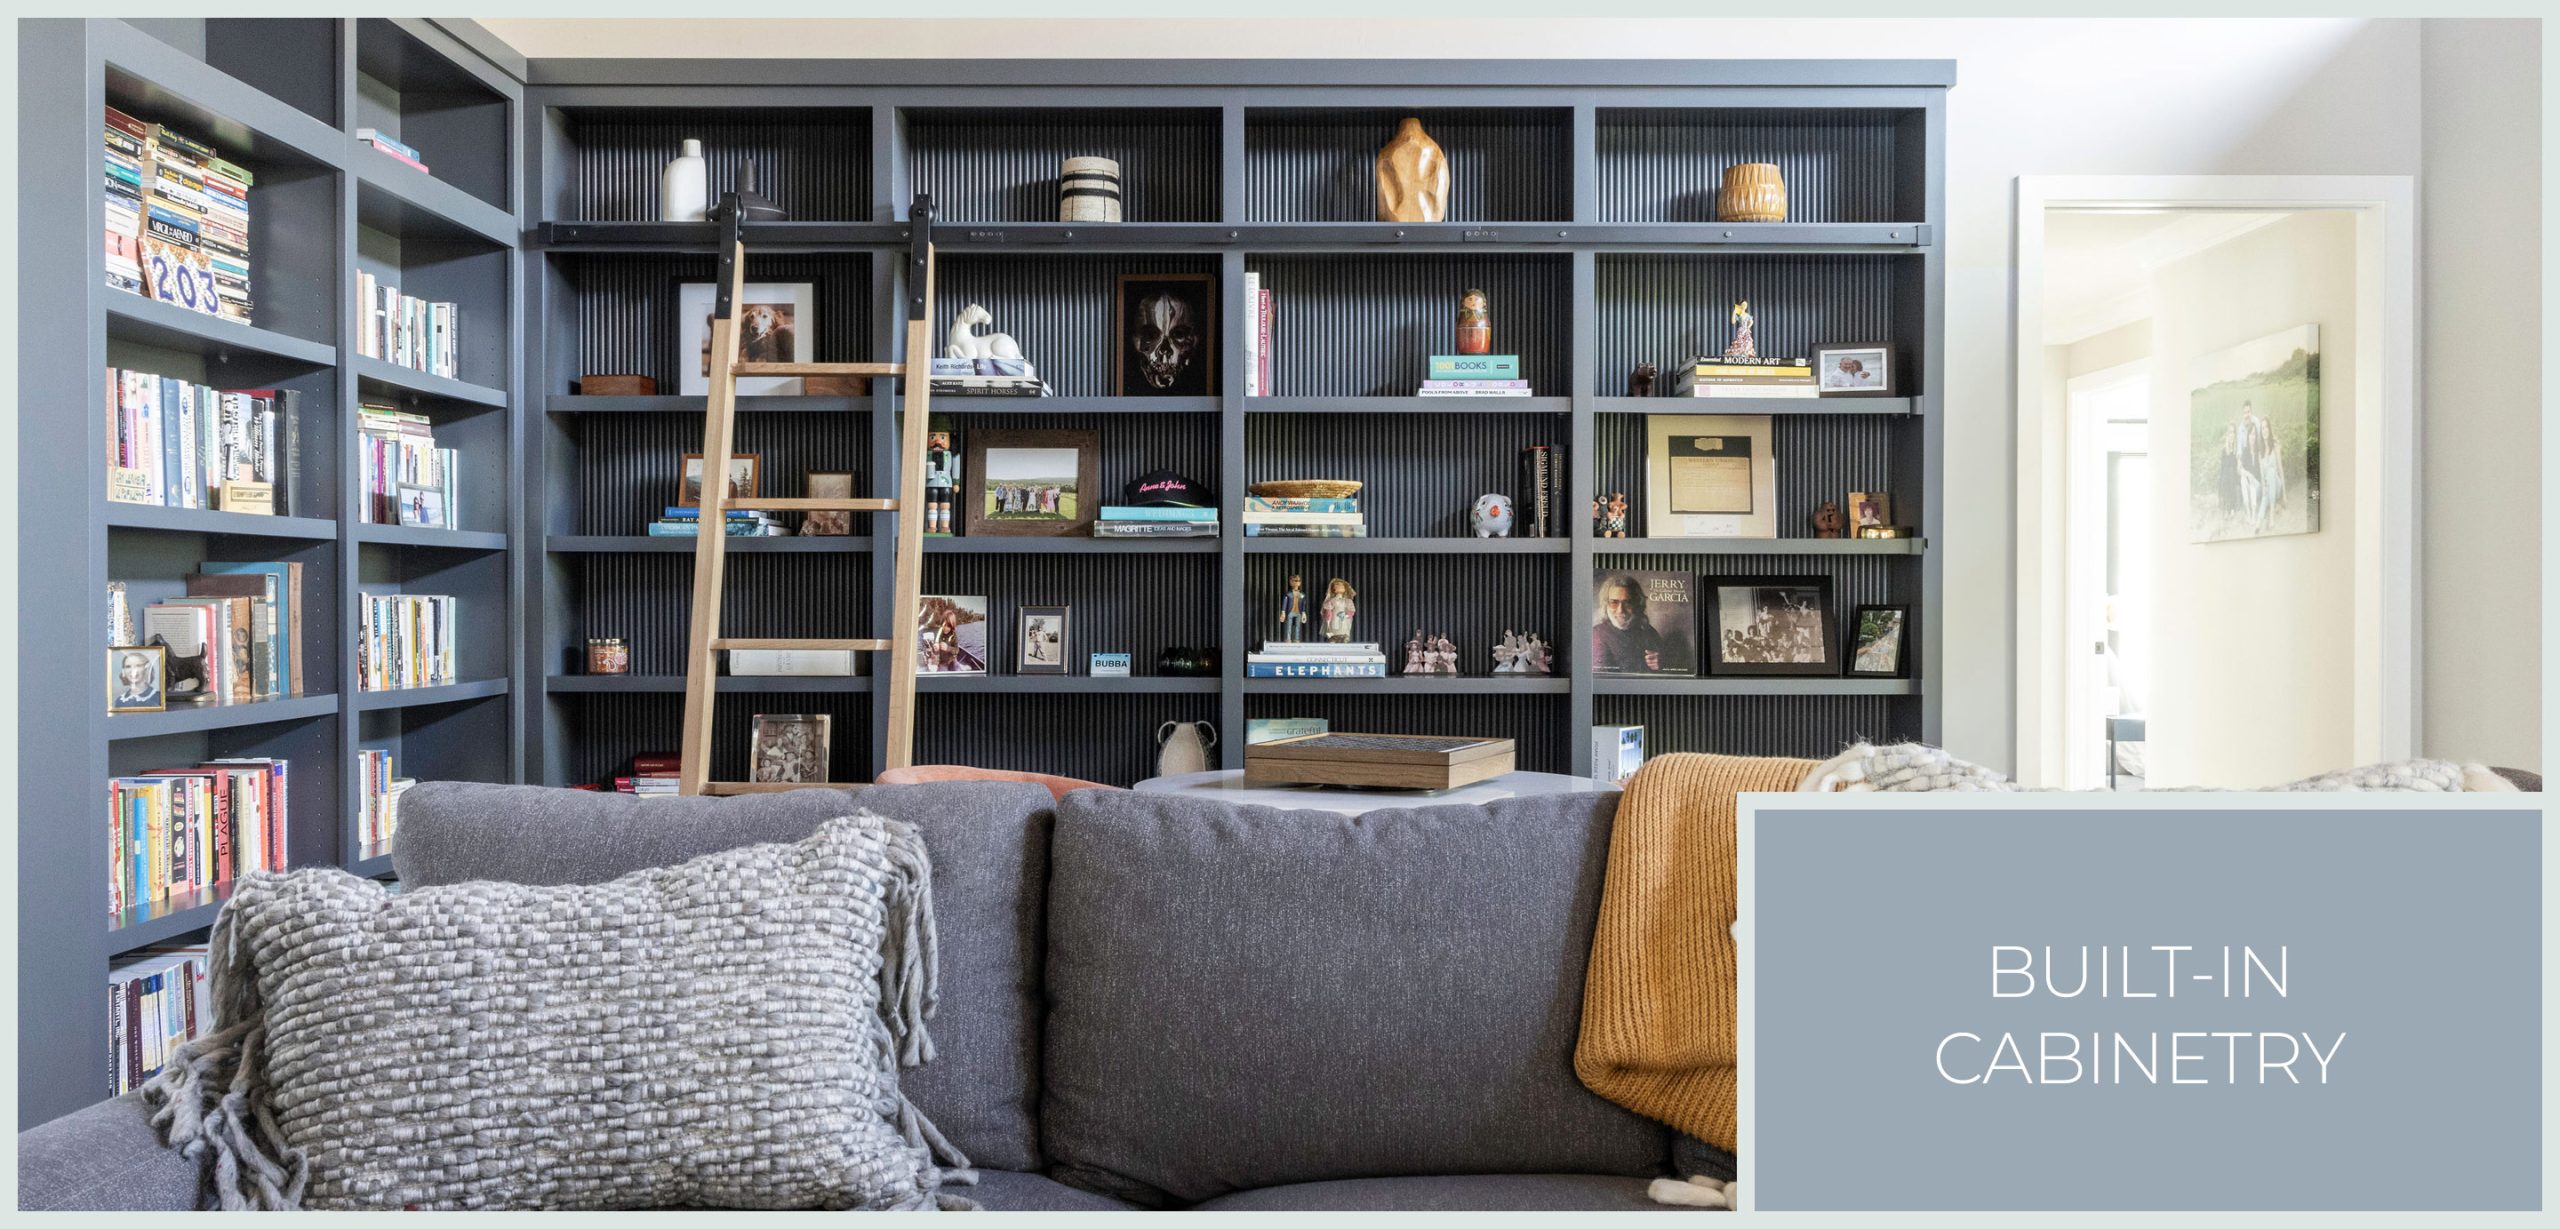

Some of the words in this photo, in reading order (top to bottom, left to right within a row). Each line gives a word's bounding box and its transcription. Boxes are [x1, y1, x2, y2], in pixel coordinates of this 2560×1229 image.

[1454, 361, 1487, 370] BOOKS
[1724, 357, 1762, 365] MODERN
[1763, 357, 1781, 366] ART
[1165, 480, 1187, 492] John
[1114, 525, 1153, 533] MAGRITTE
[1649, 578, 1686, 591] JERRY
[1649, 593, 1689, 602] GARCIA
[1095, 660, 1128, 668] BUBBA
[1275, 665, 1377, 676] ELEPHANTS
